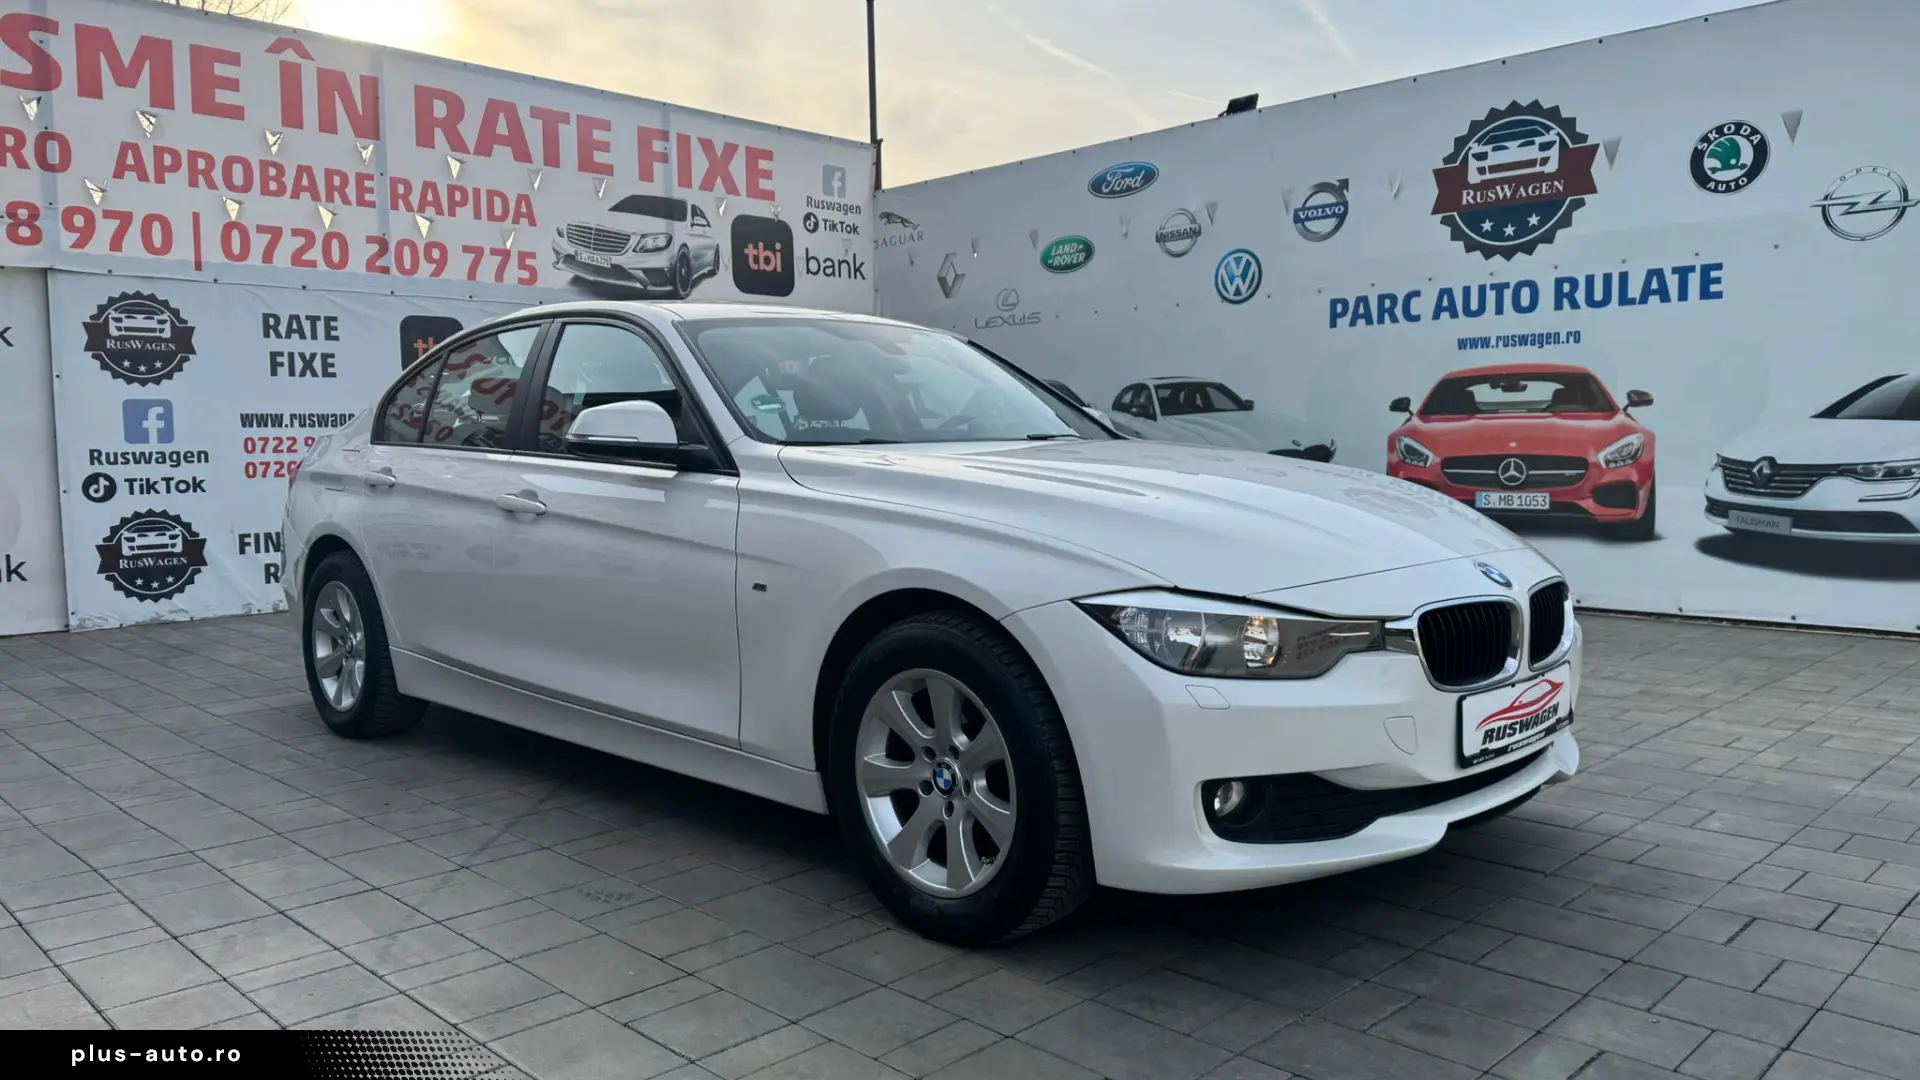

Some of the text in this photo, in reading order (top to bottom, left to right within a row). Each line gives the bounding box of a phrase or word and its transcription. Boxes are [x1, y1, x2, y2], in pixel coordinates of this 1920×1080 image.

[265, 37, 381, 141] ÎN
[413, 84, 615, 177] RATE
[637, 125, 776, 202] FIXE
[112, 140, 377, 209] APROBARE
[389, 176, 538, 228] RAPIDA
[1102, 166, 1146, 194] Ford
[1706, 176, 1748, 191] AUTO
[1838, 168, 1893, 182] OPEL
[806, 195, 862, 216] Ruswagen
[1297, 204, 1345, 220] VOLVO
[822, 218, 860, 236] TikTok
[1159, 226, 1197, 240] NISSAN
[5, 200, 43, 247] 8
[61, 205, 174, 257] 970
[220, 220, 349, 271] 0720
[365, 234, 449, 278] 209
[461, 244, 539, 287] 775
[873, 230, 925, 251] JAGUAR
[1050, 242, 1078, 256] LAND
[744, 242, 782, 273] tbi
[805, 246, 867, 282] bank
[1053, 252, 1086, 267] ROVER
[1329, 262, 1725, 328] PARC AUTO RULATE
[261, 312, 340, 342] RATE
[974, 312, 1043, 329] LEXUS
[1456, 329, 1582, 351] www.ruswagen.ro
[269, 351, 338, 379] FIXE
[243, 436, 298, 454] 0722
[88, 448, 210, 468] Ruswagen
[124, 475, 207, 496] TikTok
[1516, 495, 1548, 508] 1053
[1481, 701, 1560, 747] RUSWAGEN
